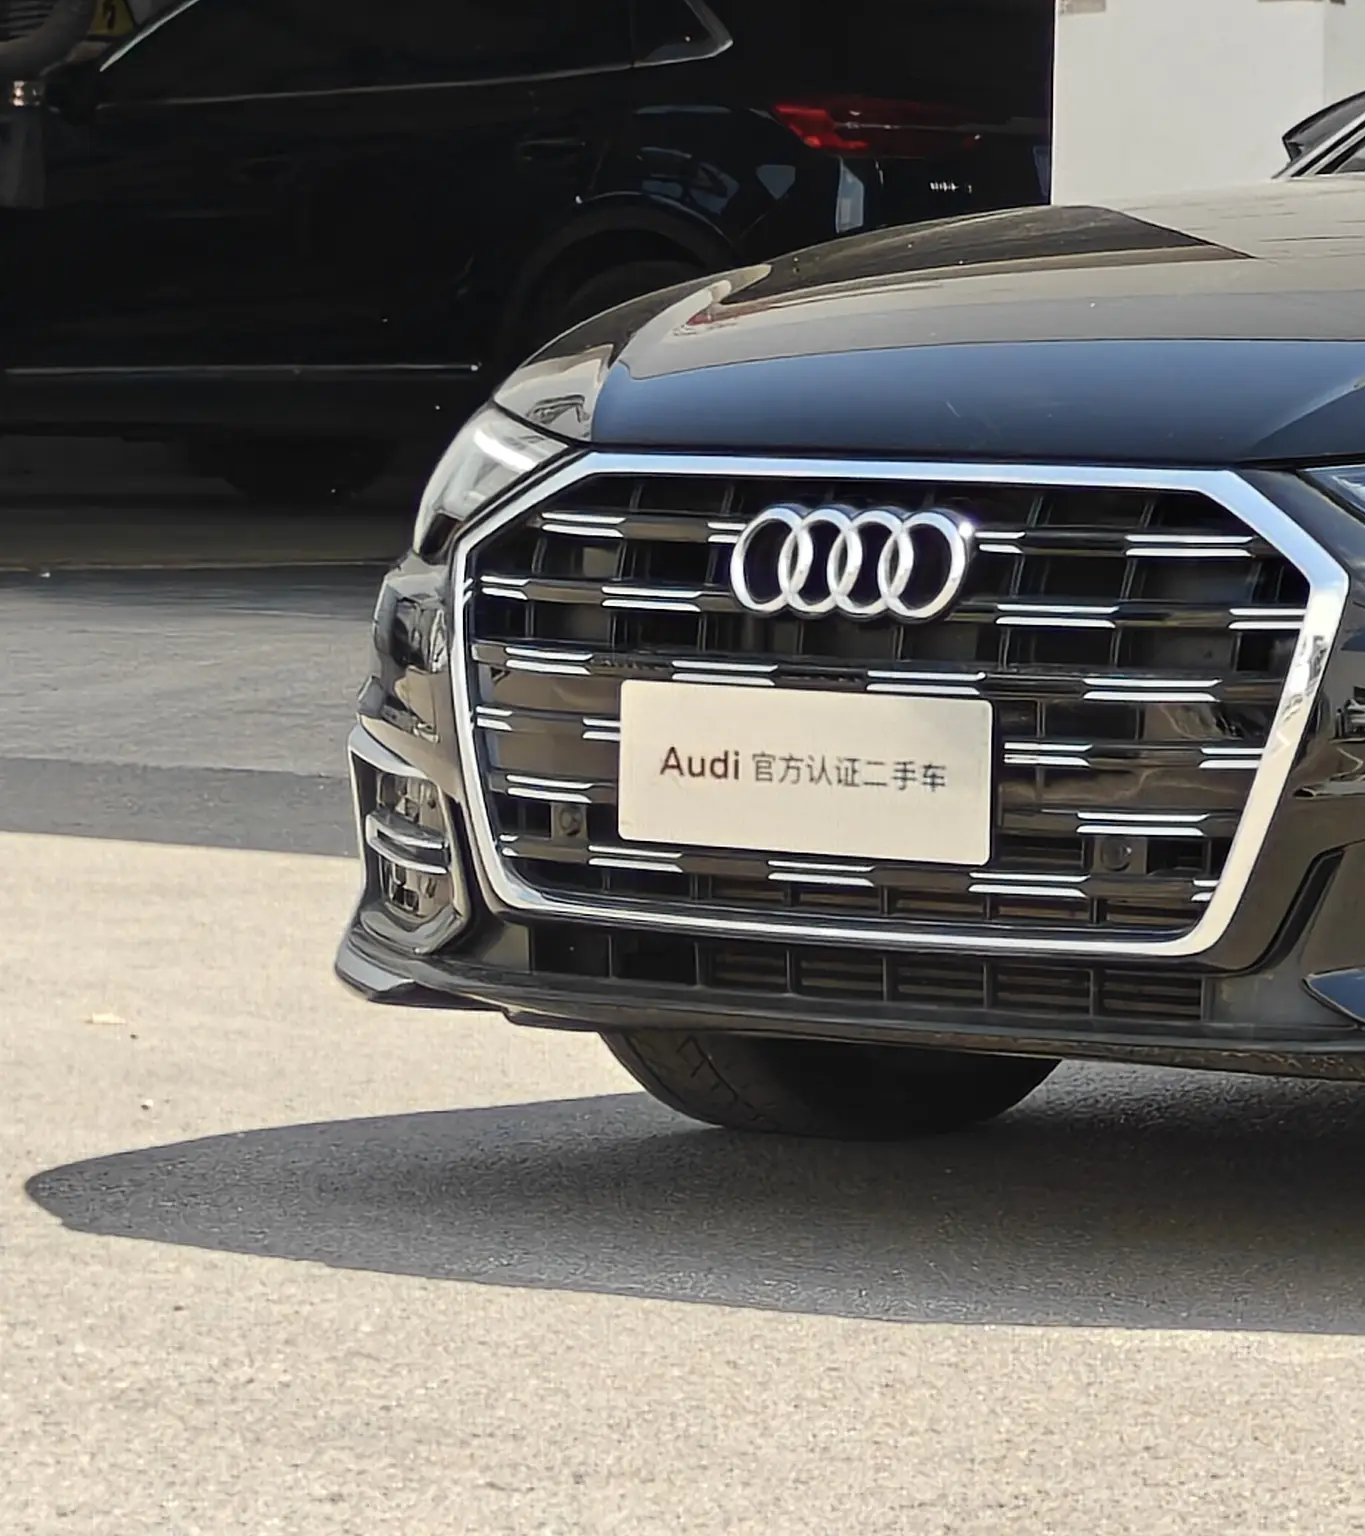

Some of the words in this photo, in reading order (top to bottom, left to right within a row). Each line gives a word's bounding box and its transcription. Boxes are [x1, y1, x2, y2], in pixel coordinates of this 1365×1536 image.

[659, 746, 740, 780] Audi
[751, 751, 947, 792] 官方认证二手车
